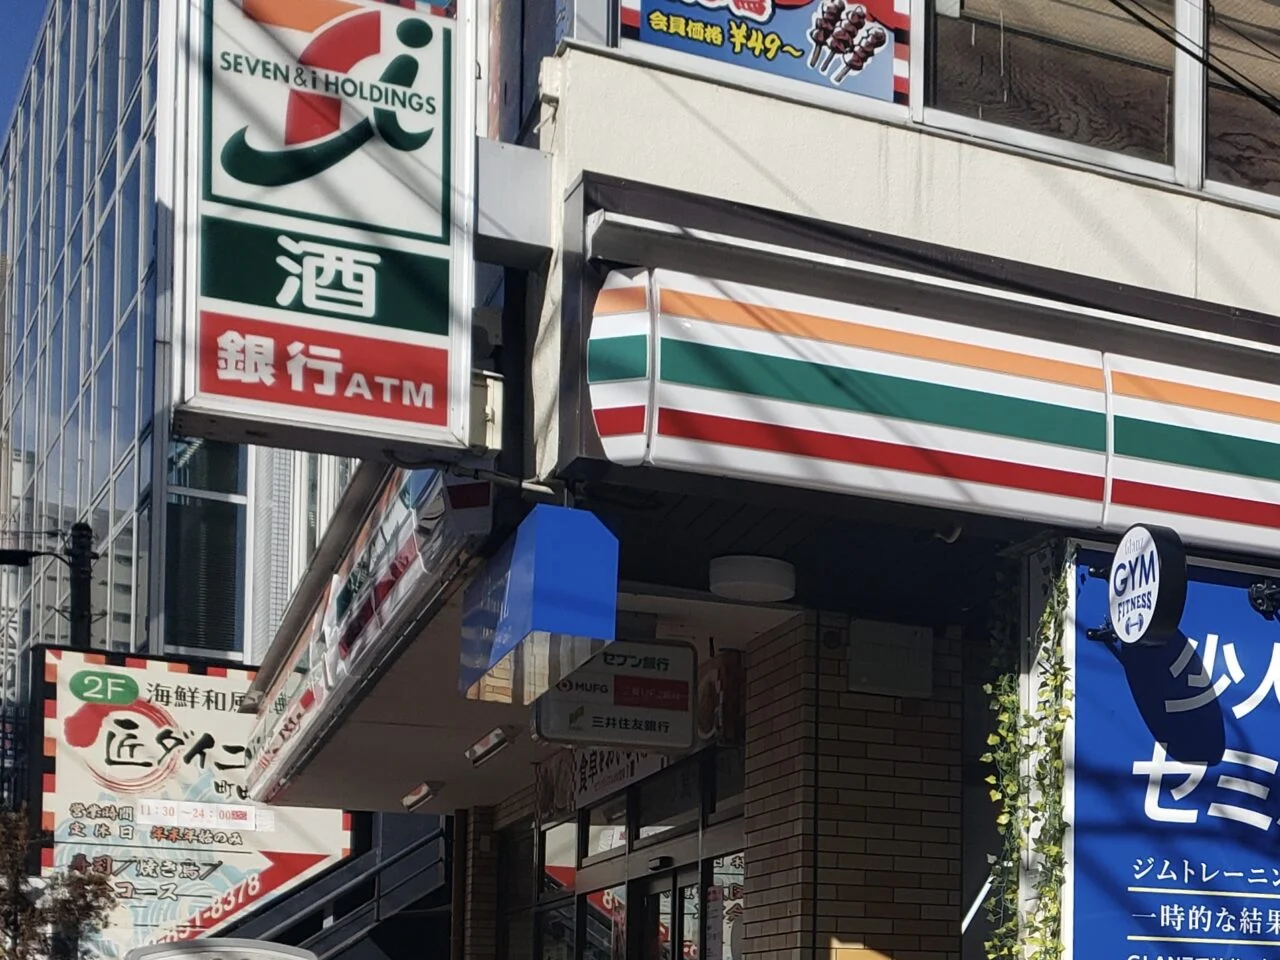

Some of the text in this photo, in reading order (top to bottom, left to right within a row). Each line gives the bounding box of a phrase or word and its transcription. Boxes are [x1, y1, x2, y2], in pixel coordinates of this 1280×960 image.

[649, 11, 723, 45] 会員価格
[325, 73, 436, 115] HOLDINGS
[276, 235, 382, 318] 酒
[1113, 550, 1156, 597] GYM
[1118, 590, 1152, 623] FITNESS
[83, 676, 127, 700] 2F
[575, 681, 609, 694] MUFG
[592, 716, 670, 734] 三井住友銀行
